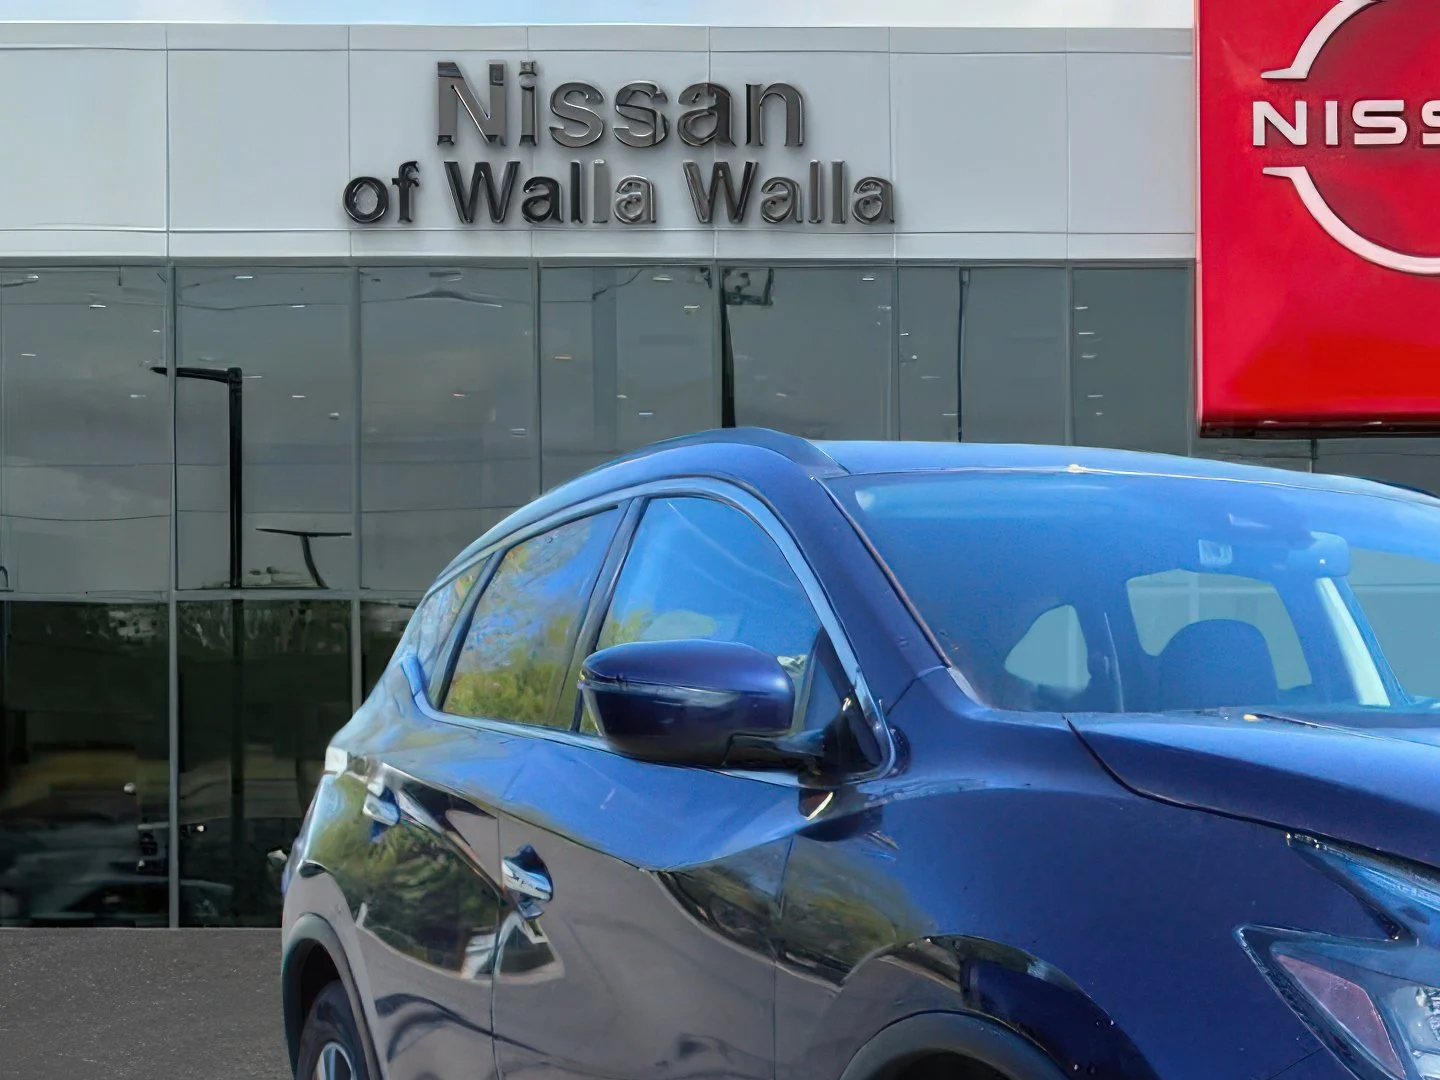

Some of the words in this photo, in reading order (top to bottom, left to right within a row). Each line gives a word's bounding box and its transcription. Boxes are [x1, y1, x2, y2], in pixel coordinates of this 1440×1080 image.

[437, 61, 805, 148] Nissan
[343, 161, 422, 224] of
[444, 160, 656, 225] Walla
[682, 160, 895, 225] Walla
